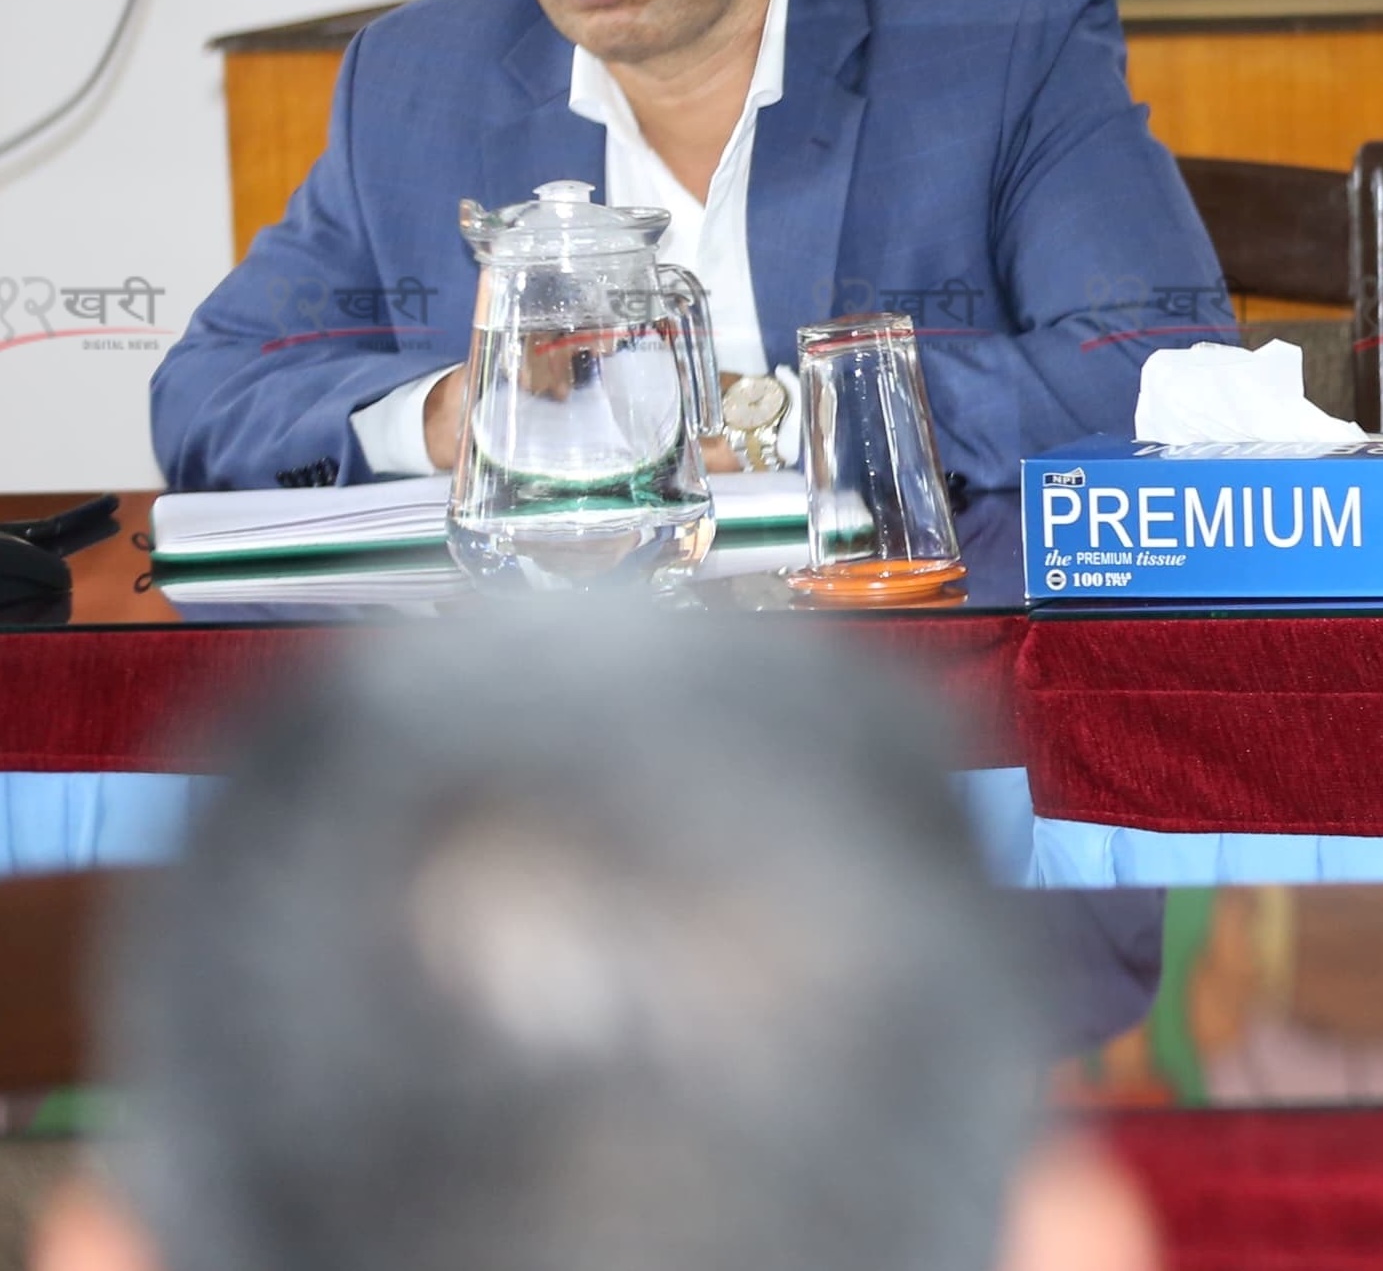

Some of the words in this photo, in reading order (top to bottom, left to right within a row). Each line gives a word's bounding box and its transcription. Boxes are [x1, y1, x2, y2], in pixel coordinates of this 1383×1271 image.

[1043, 486, 1362, 548] PREMIUM
[1045, 549, 1072, 567] the
[1076, 552, 1133, 566] PREMIUM
[1136, 550, 1187, 567] tissue
[1073, 572, 1103, 587] 100
